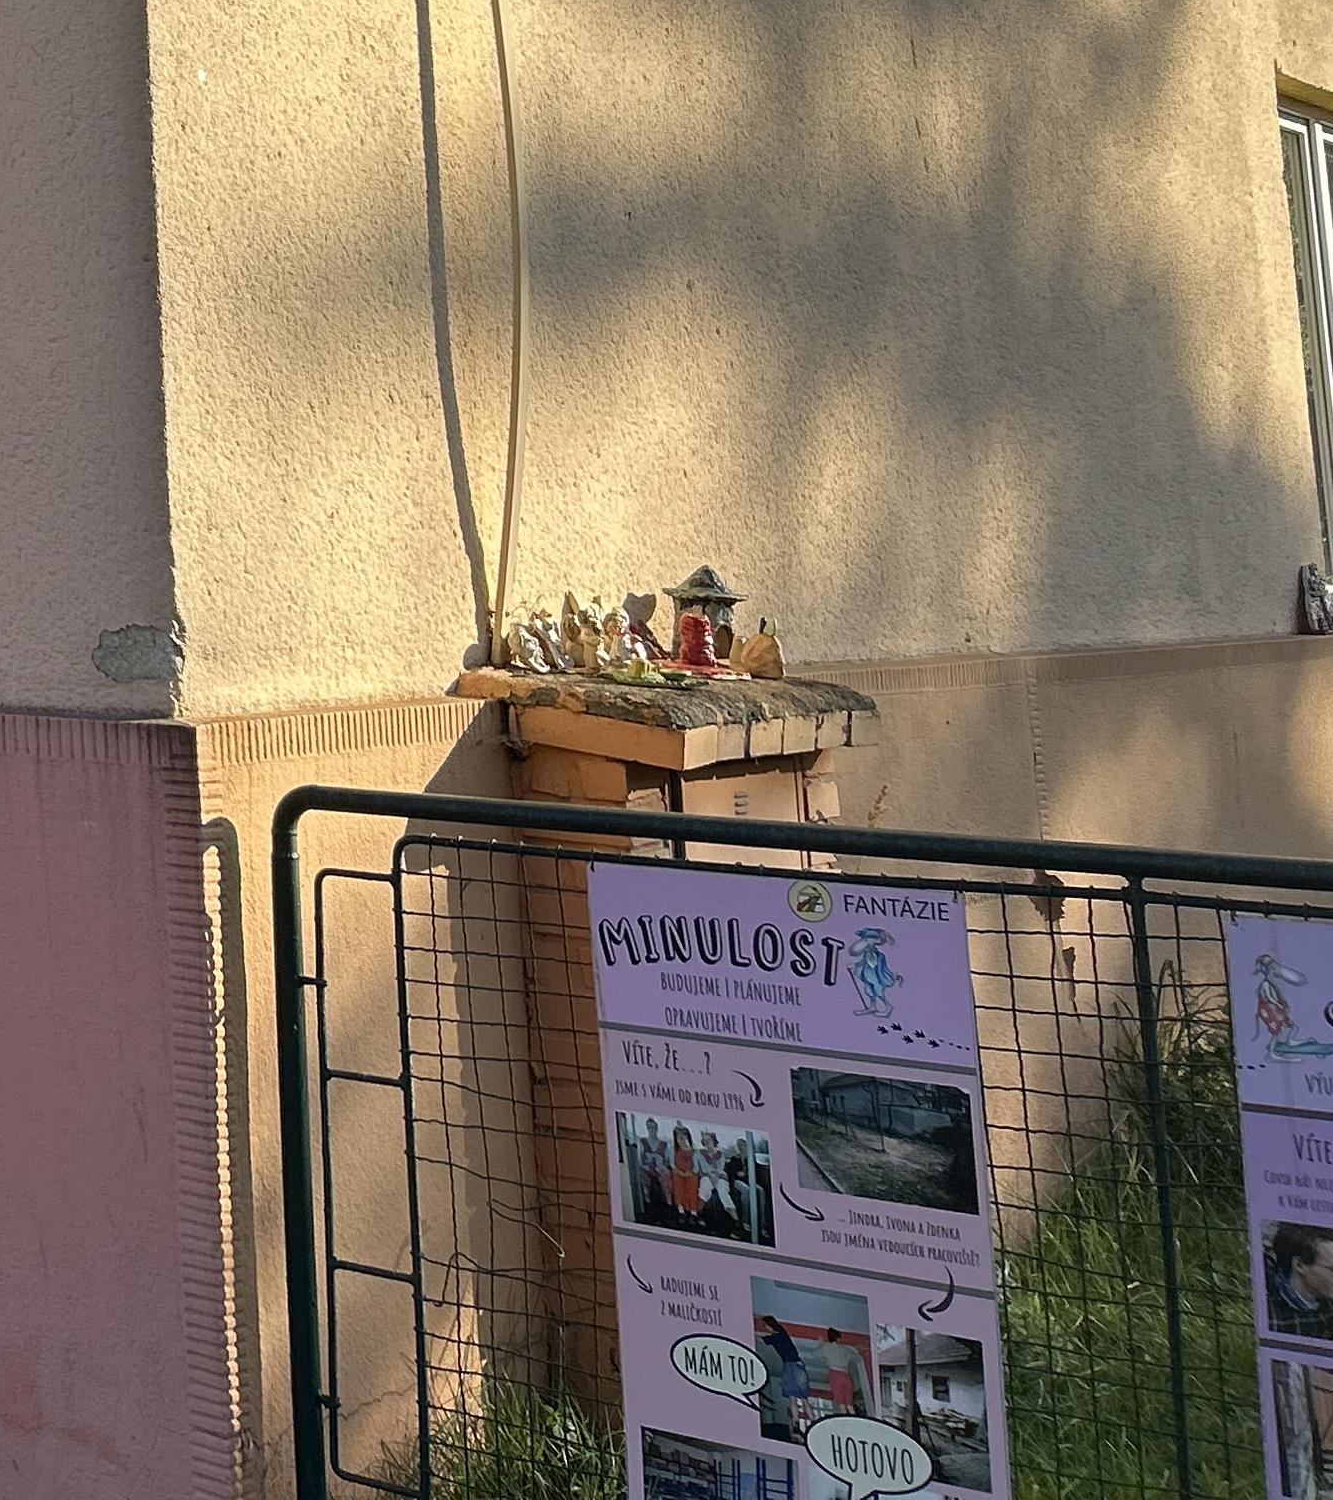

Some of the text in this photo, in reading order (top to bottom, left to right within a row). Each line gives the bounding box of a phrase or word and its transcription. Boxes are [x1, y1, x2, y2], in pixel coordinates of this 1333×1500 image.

[842, 893, 950, 922] FANTÁZIE
[598, 913, 845, 987] MINULOST
[660, 971, 722, 997] BUDUJEME
[733, 978, 802, 1007] PLÁNUJEME
[664, 1006, 739, 1035] OPRAVUJEME
[750, 1014, 803, 1043] TVOŘÍME
[621, 1039, 659, 1070] VÍTE,
[614, 1078, 745, 1112] JSME S VÁMI OD ROKU 1996
[821, 1228, 842, 1245] JSOU
[844, 1231, 876, 1251] JMÉNA
[886, 1215, 916, 1235] IVONA
[918, 1222, 924, 1235] A
[926, 1221, 961, 1241] ZDENKA
[660, 1275, 719, 1302] RADUJEME SE
[660, 1299, 723, 1328] Z MALIČKOSTÍ
[683, 1344, 756, 1387] MÁM TO!
[830, 1433, 915, 1485] HOTOVO
